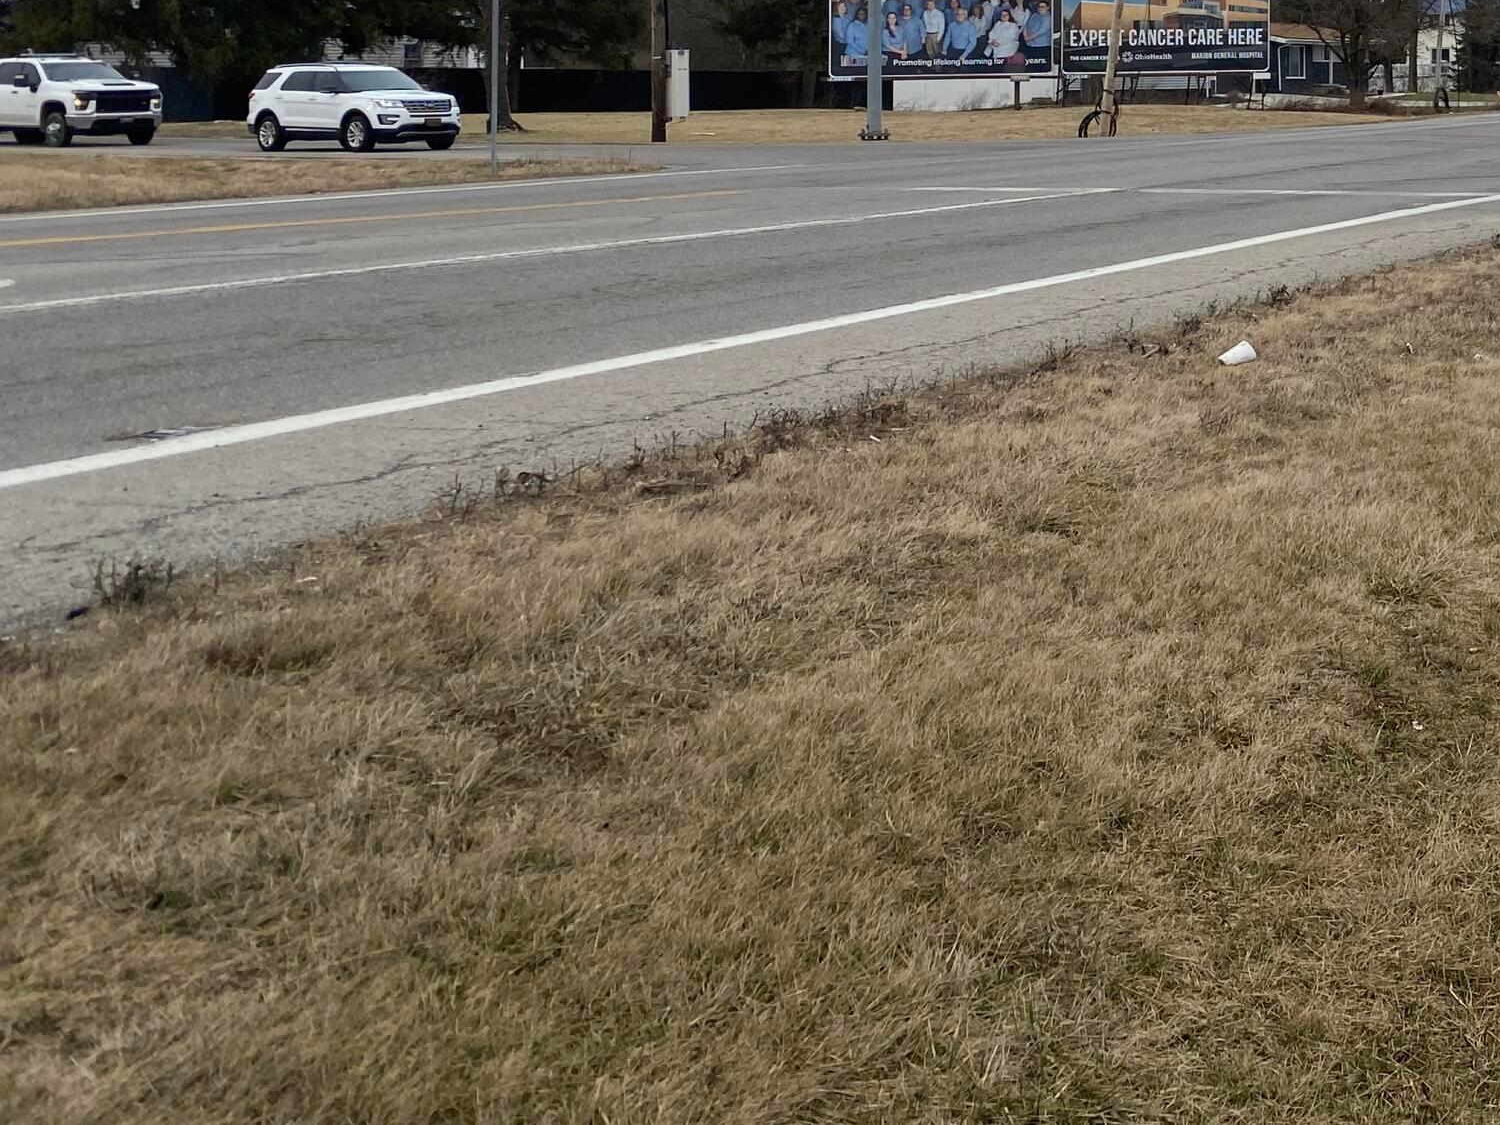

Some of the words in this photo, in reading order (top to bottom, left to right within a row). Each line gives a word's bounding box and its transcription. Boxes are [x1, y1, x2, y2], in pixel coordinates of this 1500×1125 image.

[1129, 28, 1184, 46] CANCER
[1188, 28, 1224, 46] CARE
[1228, 28, 1263, 45] HERE
[1135, 53, 1172, 61] OhioHealth
[1239, 51, 1264, 59] HOSPITAL
[893, 59, 932, 67] Promoting
[933, 58, 960, 67] lifelong
[962, 58, 993, 66] learning
[994, 57, 1004, 65] for
[1025, 58, 1047, 66] years.
